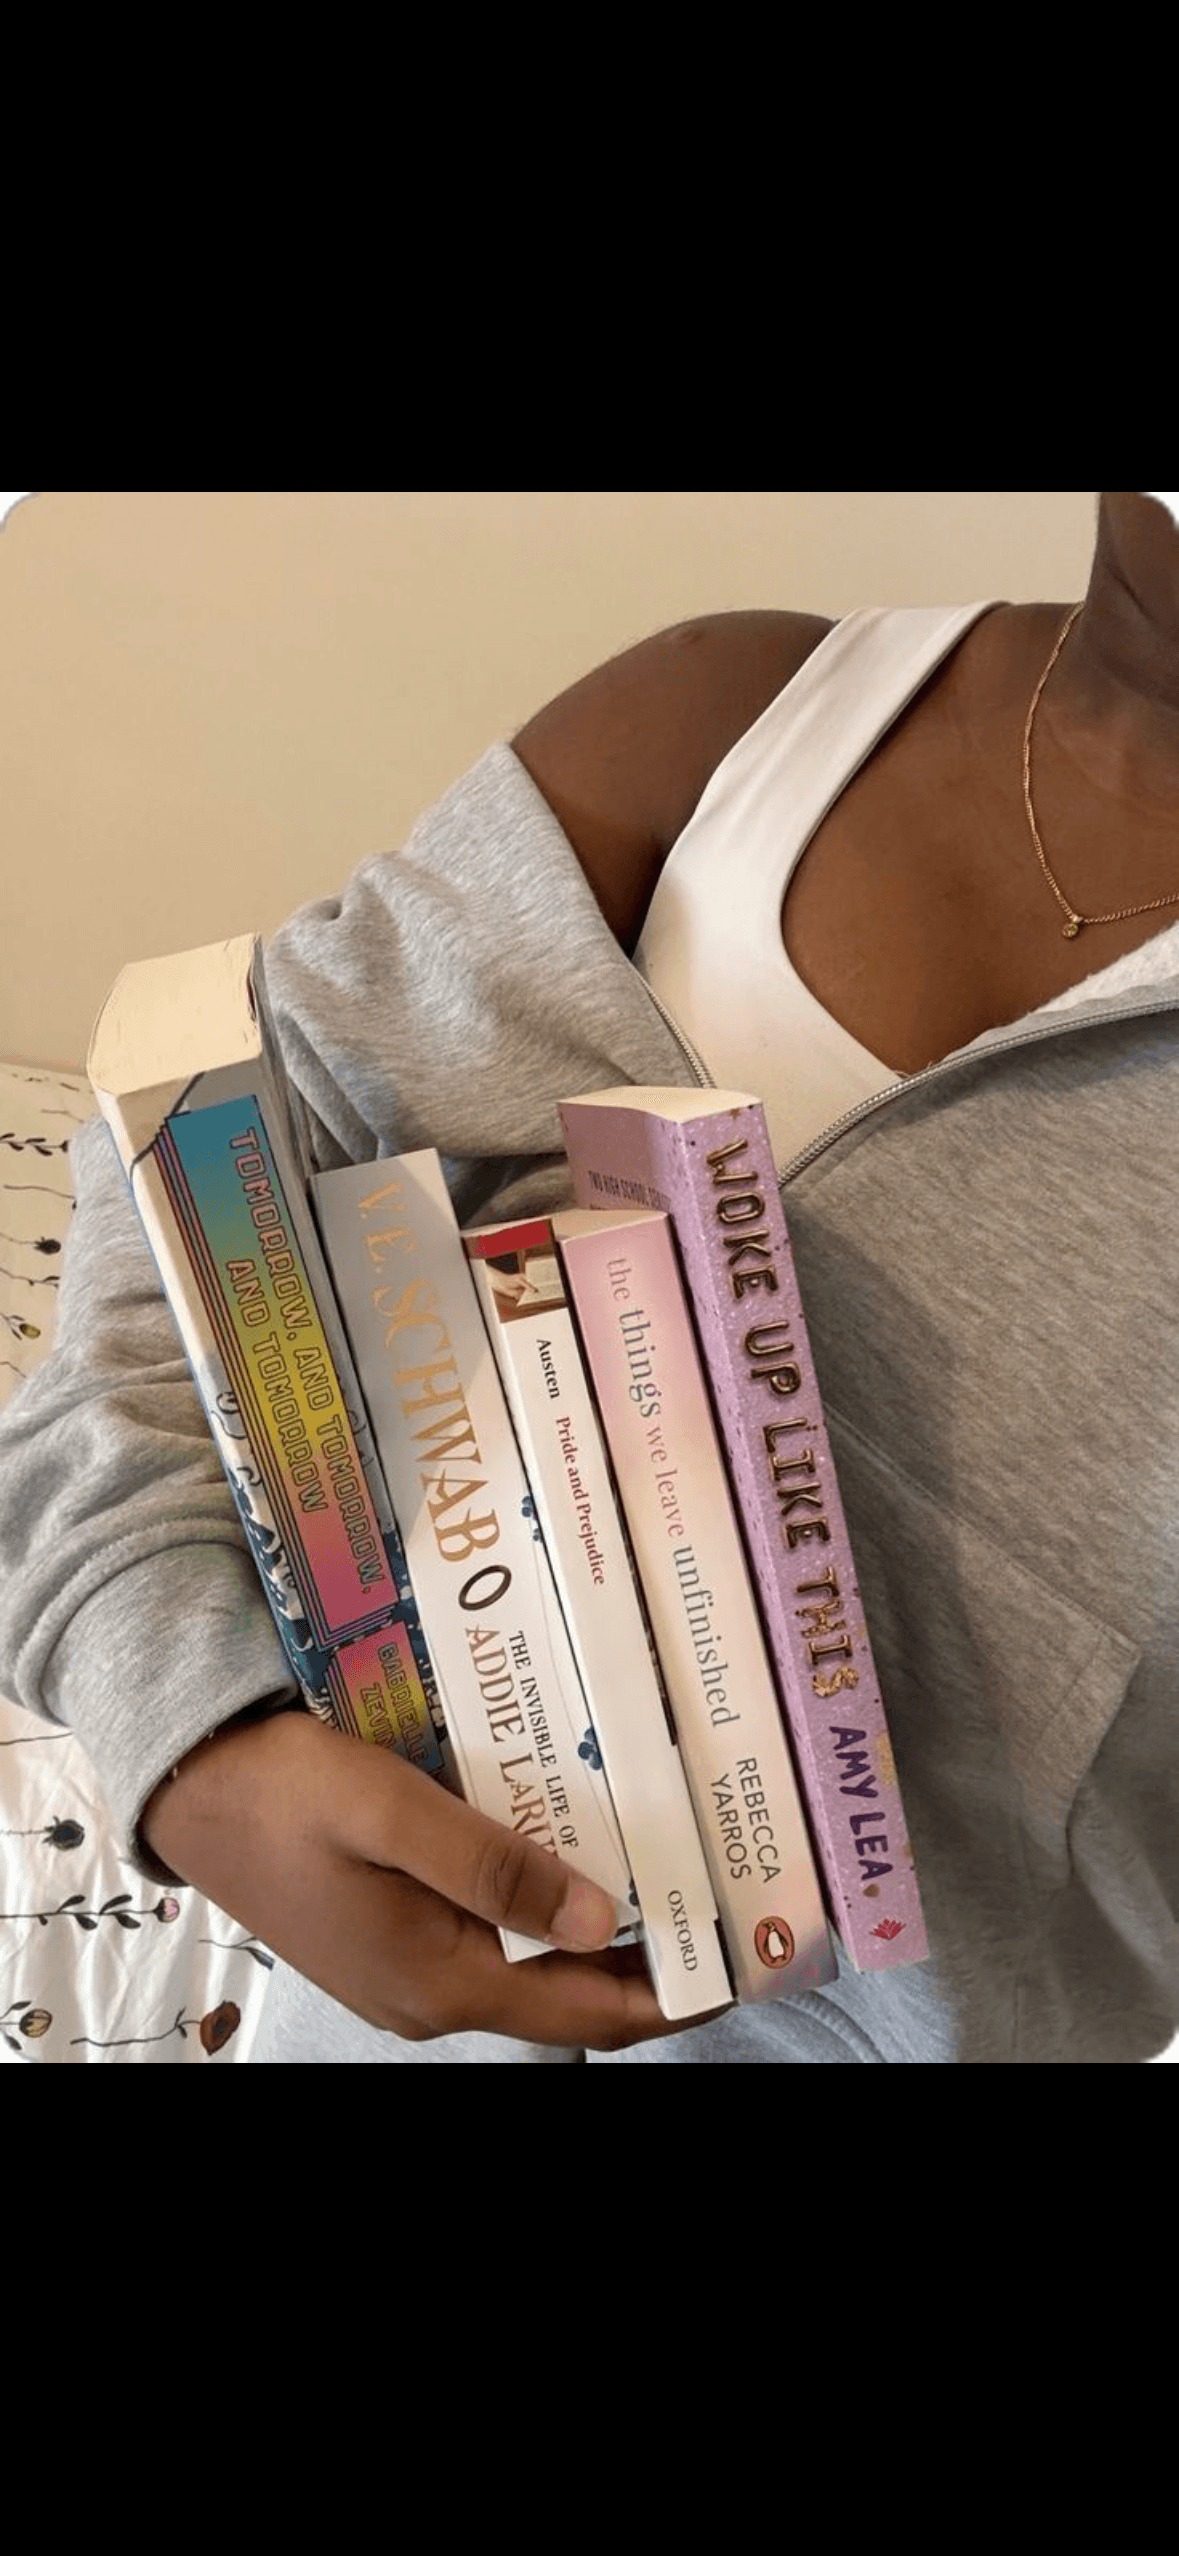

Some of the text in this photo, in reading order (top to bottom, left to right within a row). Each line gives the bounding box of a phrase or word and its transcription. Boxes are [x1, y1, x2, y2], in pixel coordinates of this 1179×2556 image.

[226, 1258, 329, 1514] AND TOMORROW
[293, 1346, 335, 1411] AND
[371, 1276, 501, 1562] SCHWAB
[536, 1338, 561, 1399] Austen
[706, 1140, 860, 1698] WOKE UP LIKE THIS
[555, 1416, 605, 1586] Pride and Prejudice
[606, 1257, 741, 1728] the things we leave unfinished
[377, 1641, 429, 1763] GABRIELLE
[465, 1624, 526, 1743] ADDIE
[509, 1630, 579, 1849] THE INVISIBLE LIFE OF
[711, 1773, 752, 1881] YARROS
[736, 1757, 781, 1884] REBECCA
[829, 1725, 893, 1882] AMY LEA
[667, 1889, 698, 1972] OXFORD
